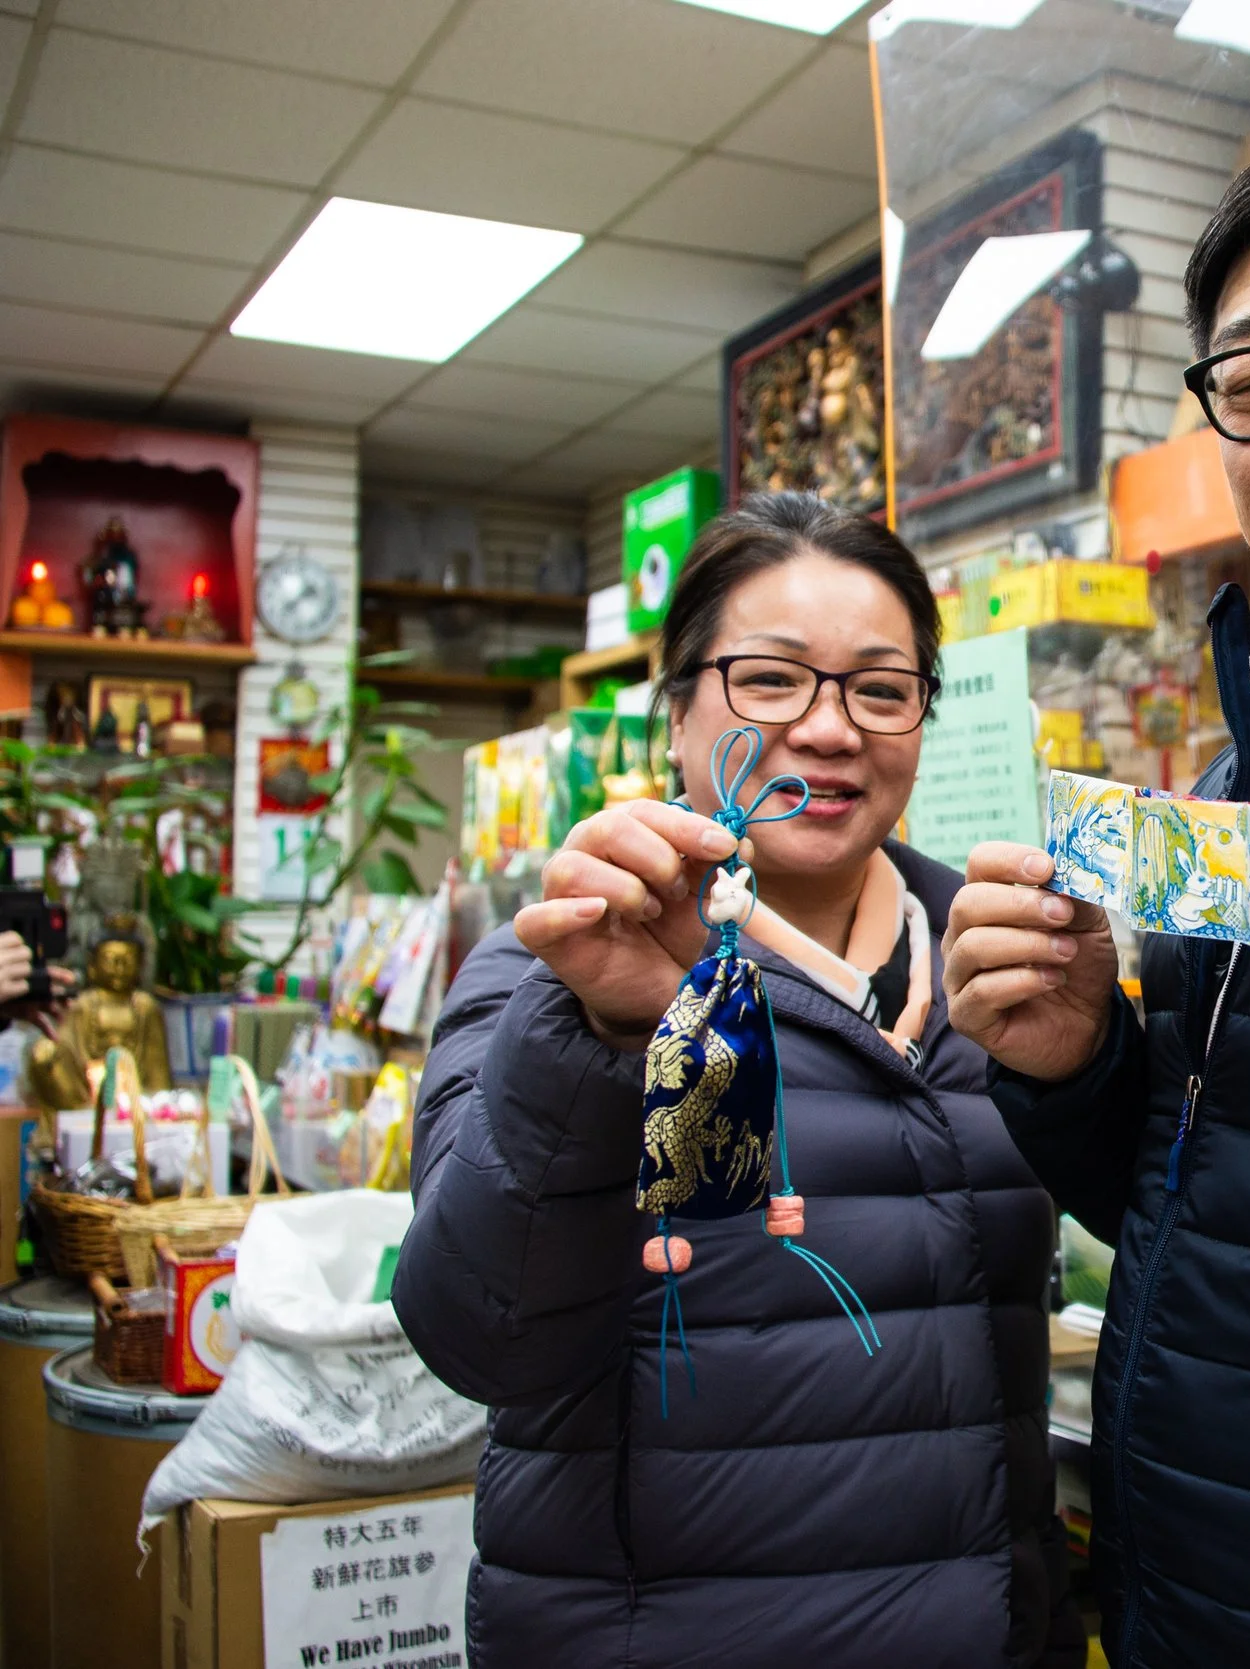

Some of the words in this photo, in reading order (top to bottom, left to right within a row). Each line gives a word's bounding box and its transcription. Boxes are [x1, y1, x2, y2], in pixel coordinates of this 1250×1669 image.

[323, 1515, 422, 1549] 特大五年
[312, 1551, 436, 1591] 新鮮花旗參
[352, 1593, 400, 1623] 上市
[300, 1644, 331, 1669] We
[336, 1634, 384, 1662] Have
[388, 1623, 451, 1653] Jumbo
[383, 1652, 462, 1669] Wisconsin
